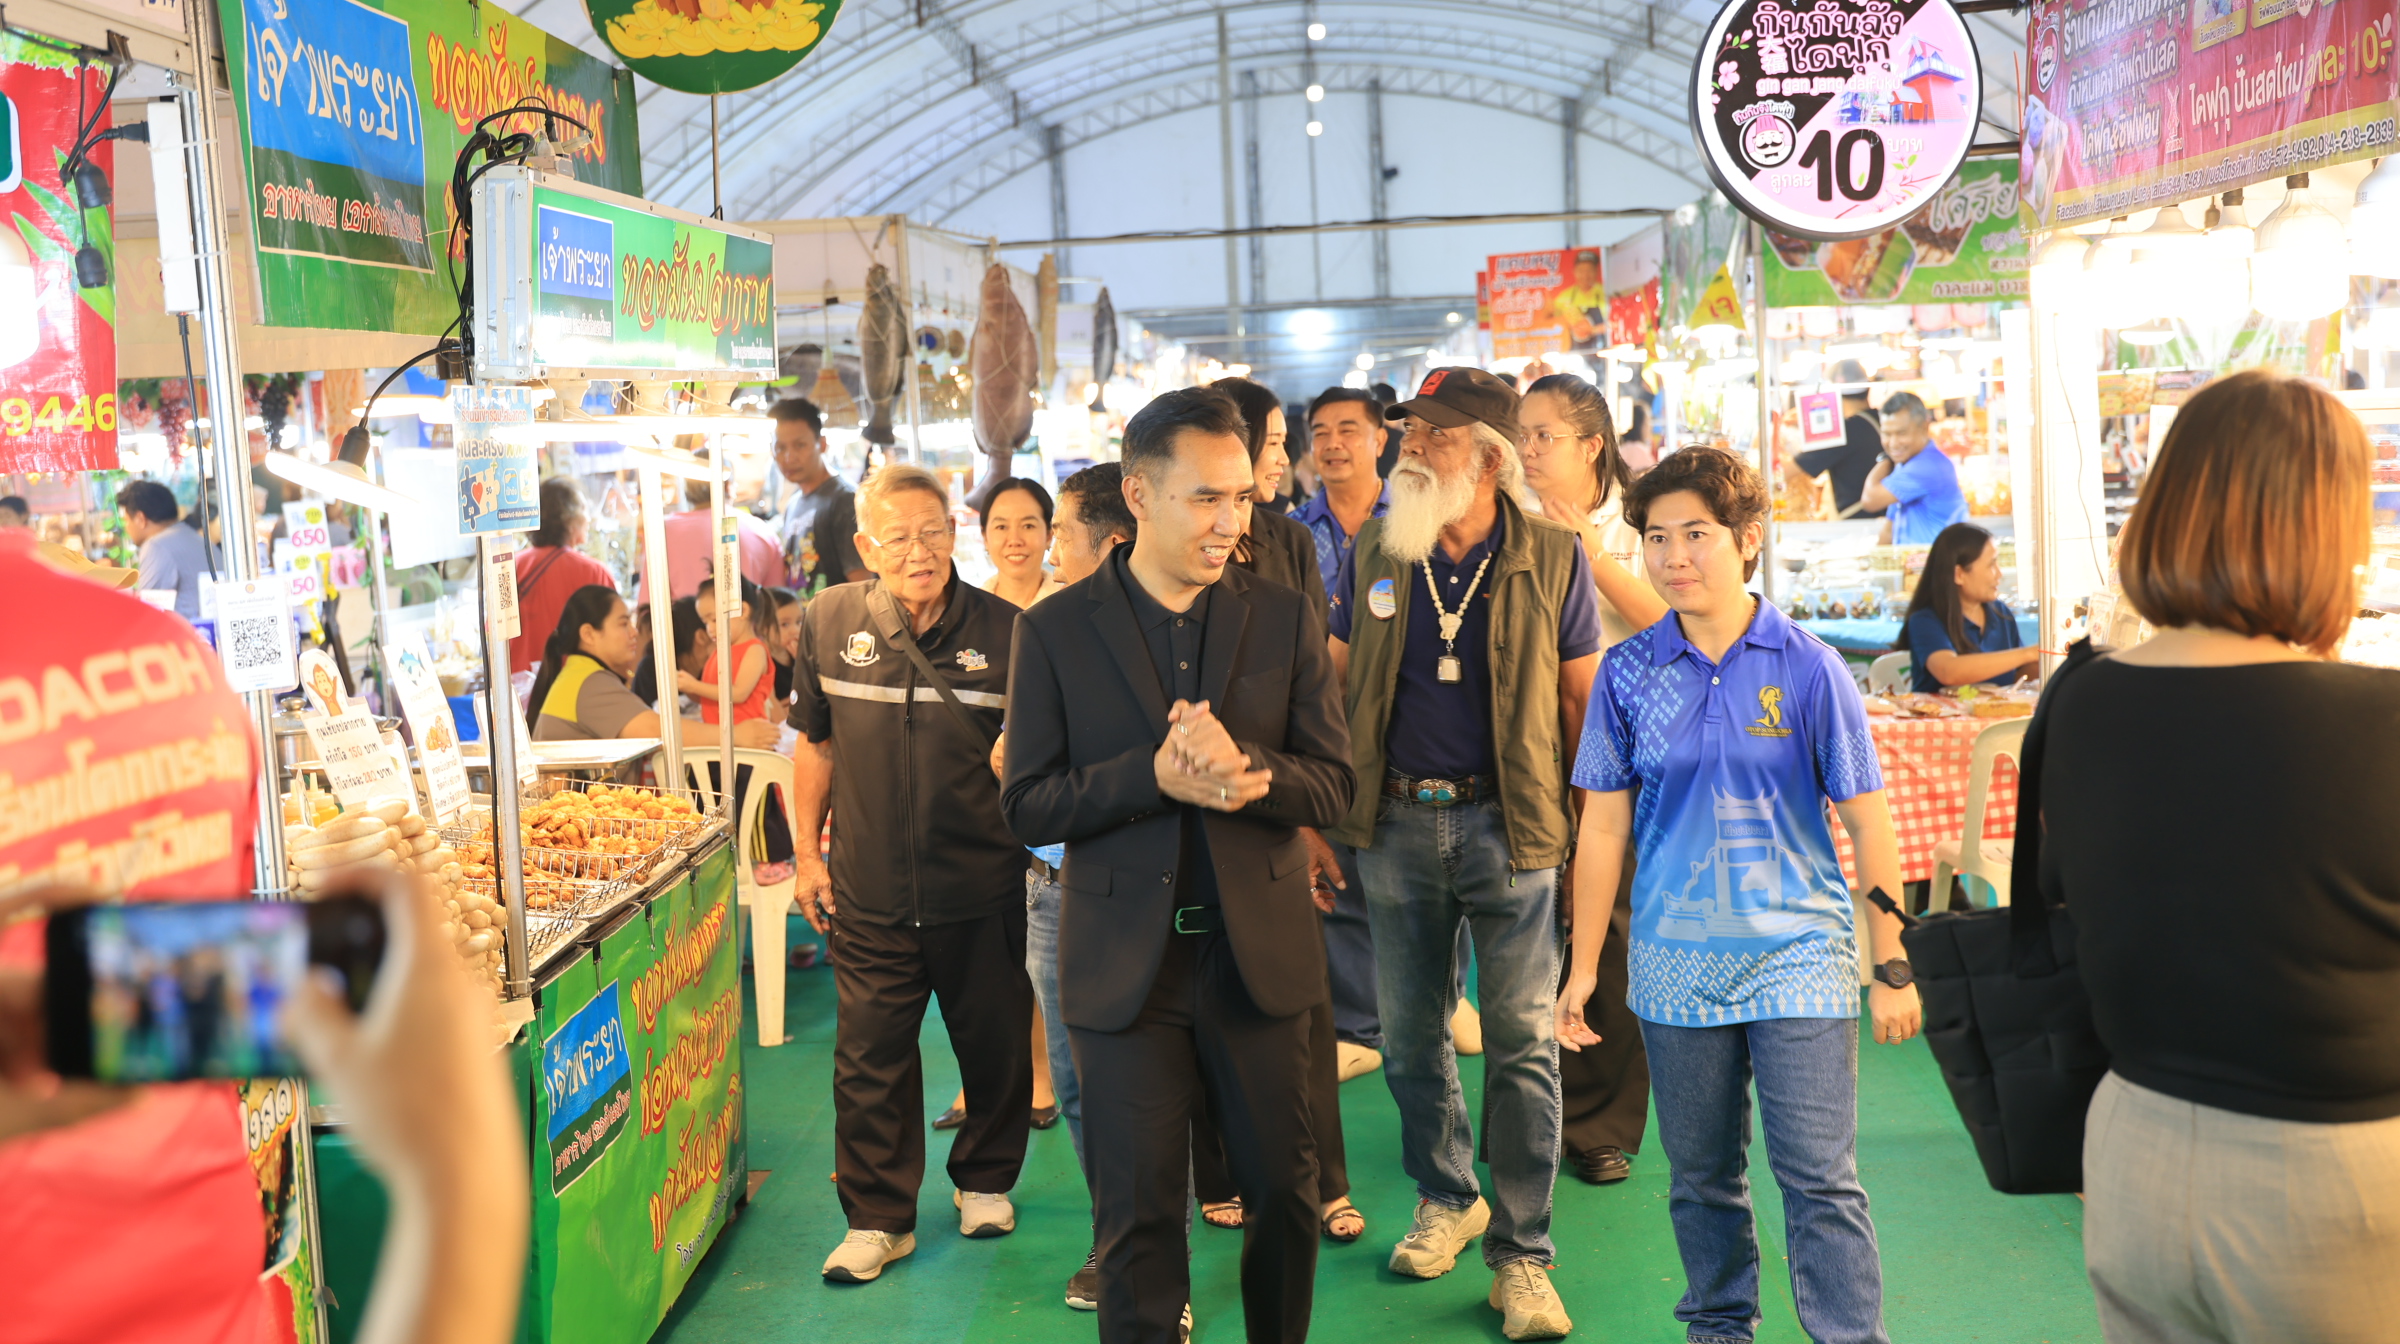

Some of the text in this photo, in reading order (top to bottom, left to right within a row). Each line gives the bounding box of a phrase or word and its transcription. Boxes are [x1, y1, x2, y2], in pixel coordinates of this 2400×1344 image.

[1754, 1, 1904, 37] กินกันจัง
[1785, 36, 1893, 75] ไดฟุกุ
[1756, 77, 1781, 97] gin
[1782, 77, 1811, 97] gan
[1810, 76, 1845, 97] jang
[2188, 75, 2232, 136] ไดฟุกุ
[2233, 43, 2305, 114] ปั้นสดใหม่
[1770, 171, 1812, 196] ลูกละ
[1798, 128, 1886, 203] 10
[542, 226, 773, 337] เจ้าพระยา ทอดมันปลากราย
[0, 392, 117, 437] 9446
[291, 528, 326, 548] 650
[348, 745, 363, 759] 150
[364, 743, 380, 754] บาท
[376, 767, 393, 779] บาท
[546, 1015, 623, 1116] เจ้าพระยา
